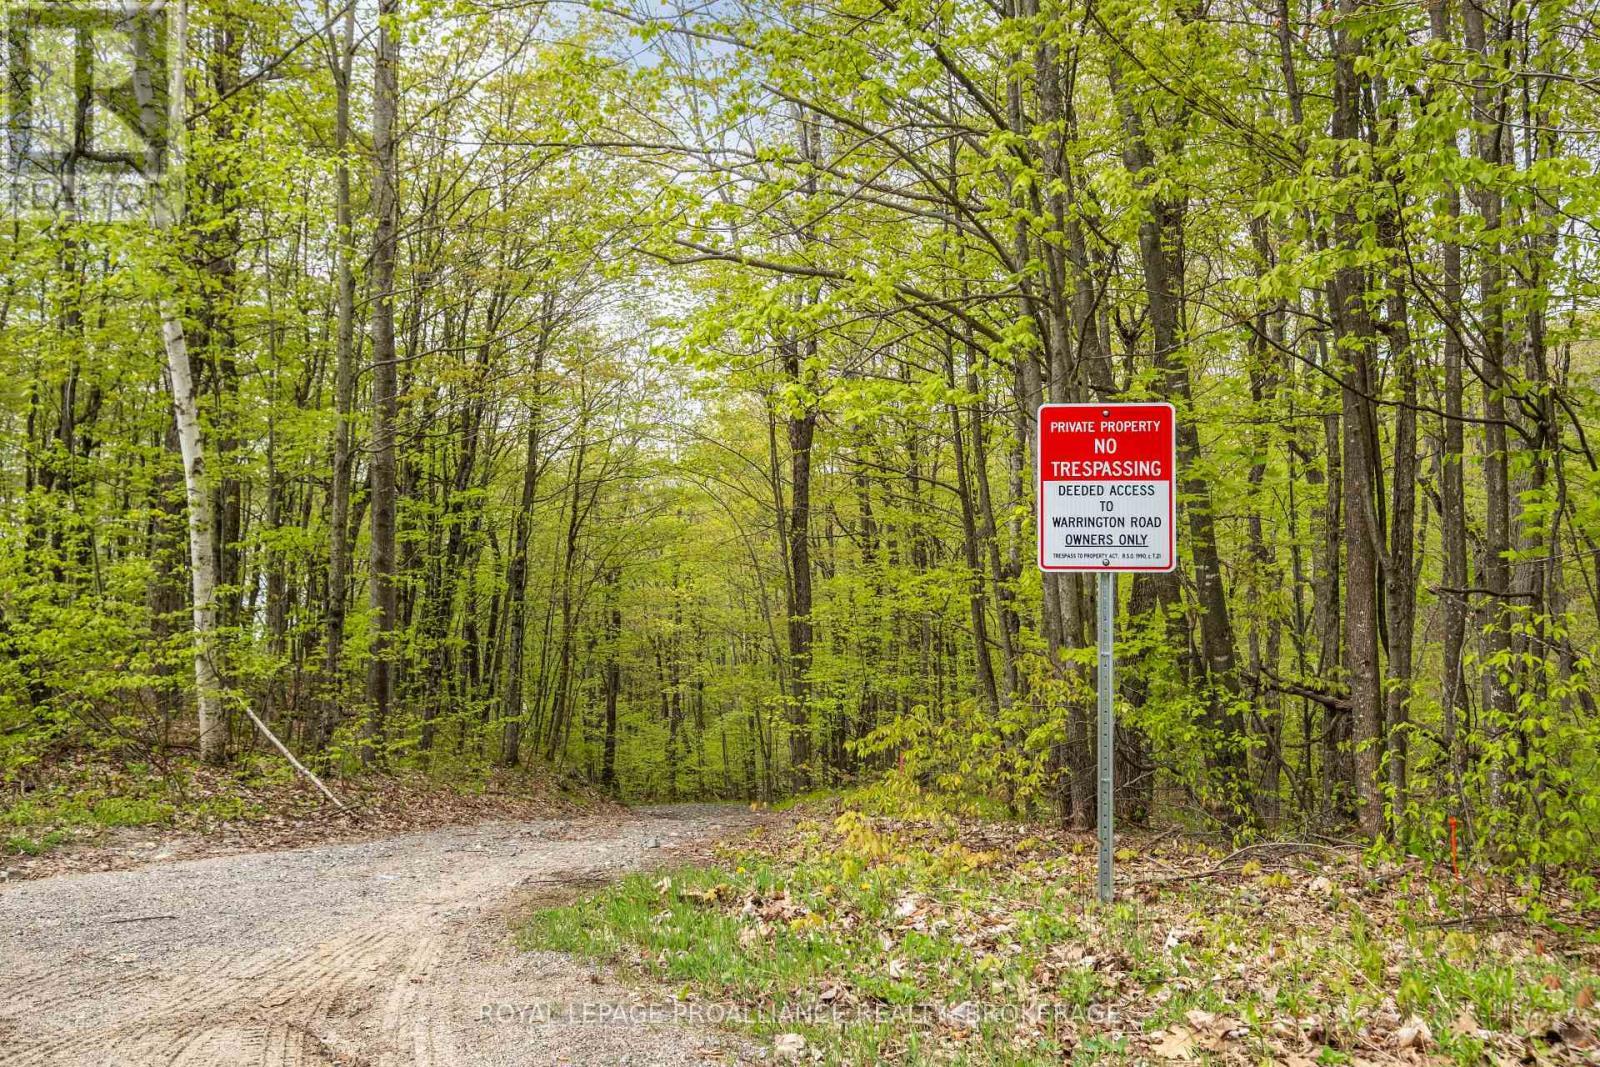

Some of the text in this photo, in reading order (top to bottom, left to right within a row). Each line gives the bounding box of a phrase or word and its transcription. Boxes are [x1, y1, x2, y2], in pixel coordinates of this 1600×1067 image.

[1050, 420, 1160, 433] PRIVATE PROPERTY
[1094, 438, 1117, 454] NO
[1051, 461, 1162, 477] TRESPASSING
[1058, 485, 1155, 496] DEEDED ACCESS
[1099, 500, 1114, 512] TO
[1052, 516, 1162, 528] WARRINGTON ROAD
[1065, 534, 1148, 546] OWNERS ONLY
